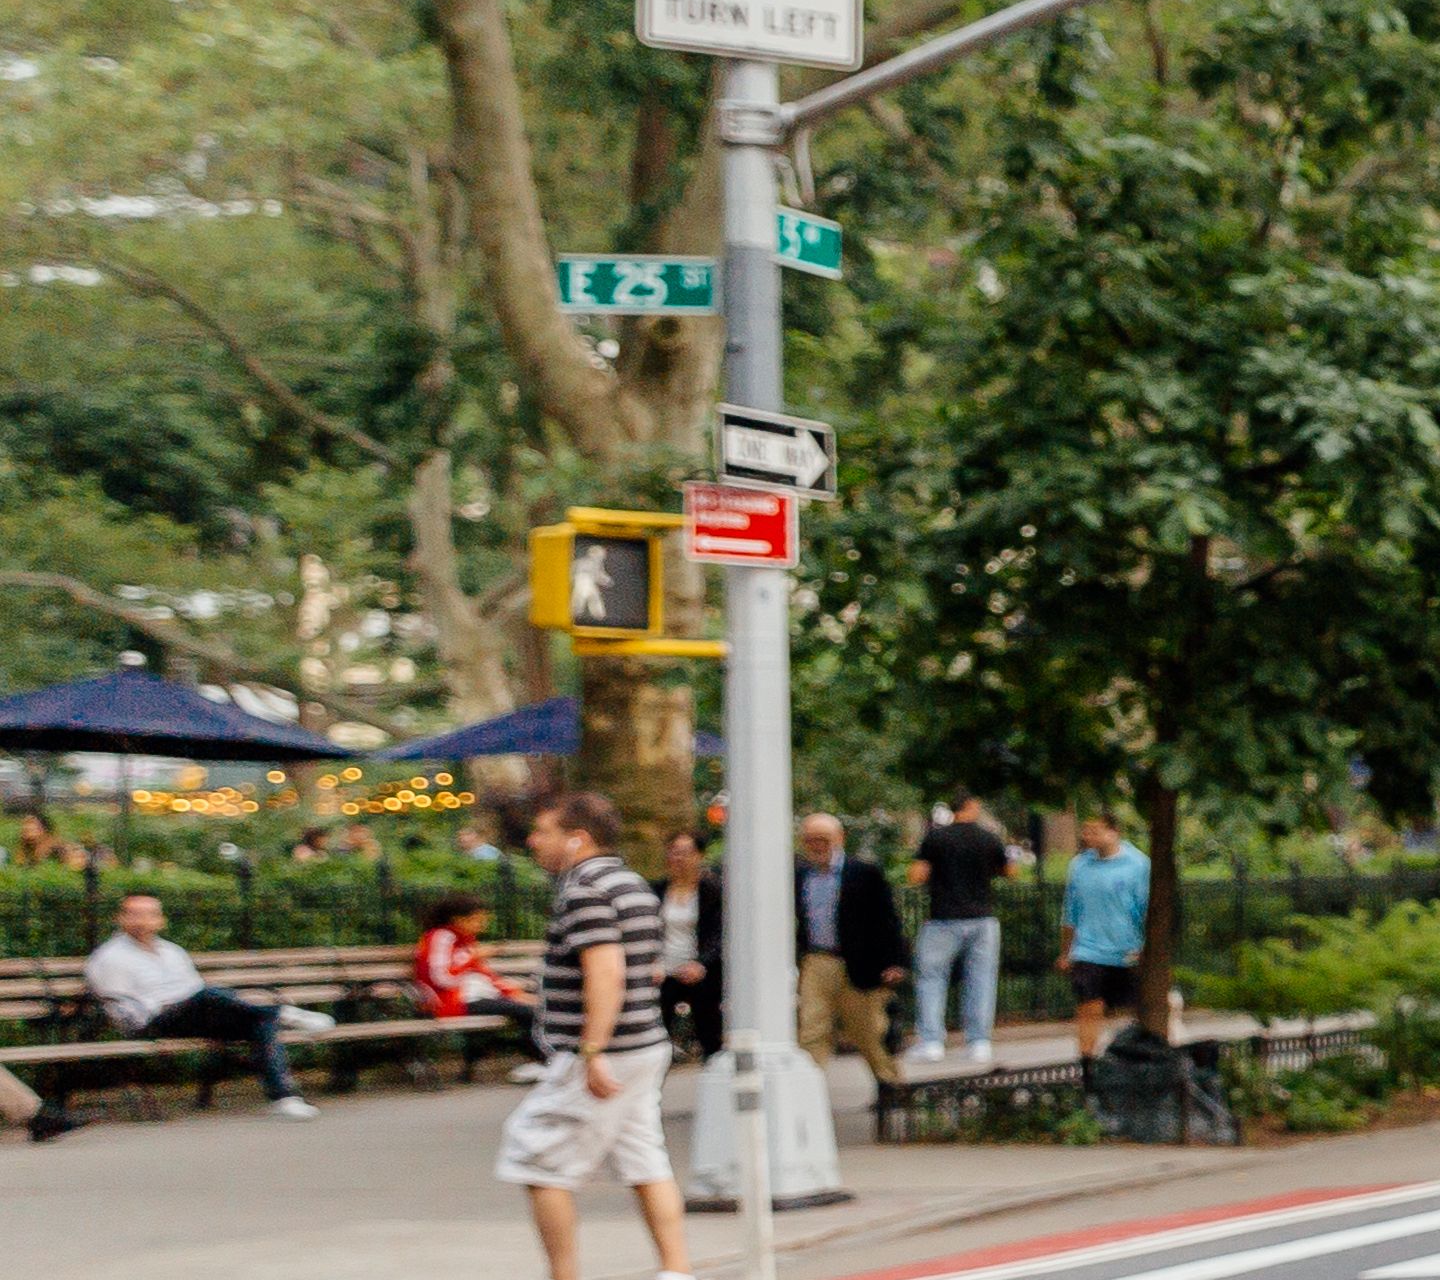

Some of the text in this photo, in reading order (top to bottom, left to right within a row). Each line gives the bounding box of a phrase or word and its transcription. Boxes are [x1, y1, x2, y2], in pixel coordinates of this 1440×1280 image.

[762, 4, 839, 41] LEFT
[568, 260, 708, 305] E 25 ST
